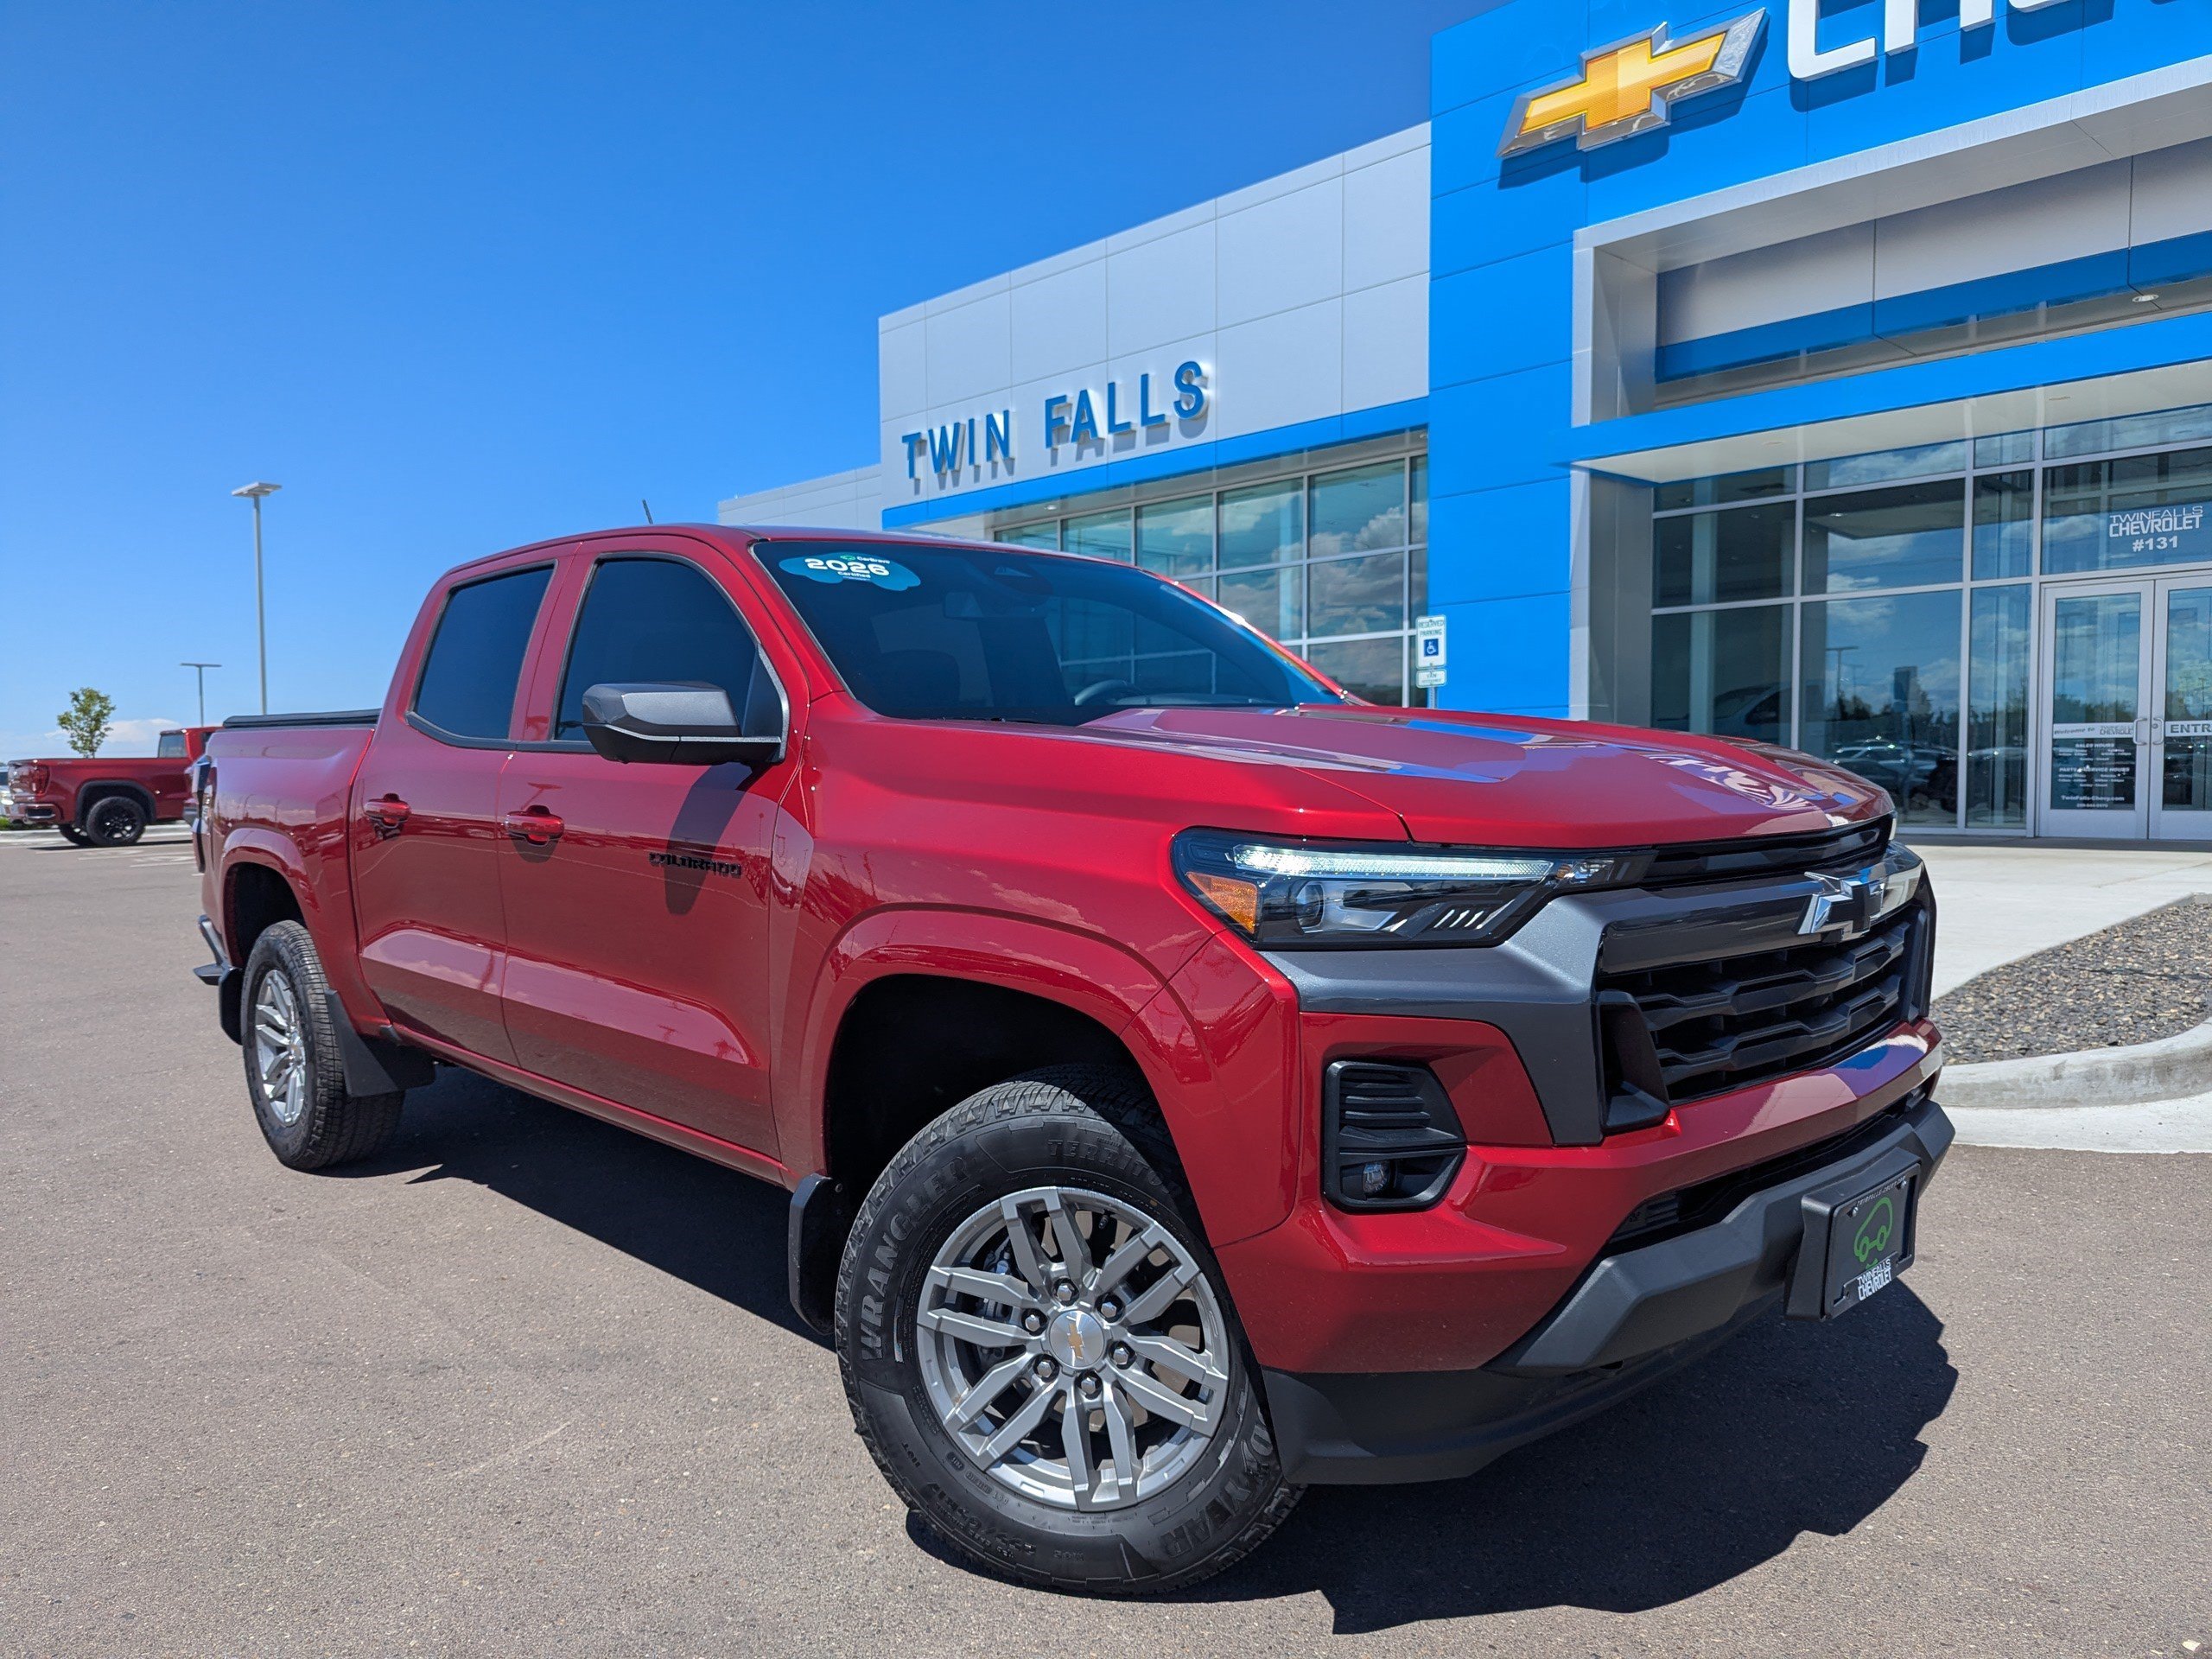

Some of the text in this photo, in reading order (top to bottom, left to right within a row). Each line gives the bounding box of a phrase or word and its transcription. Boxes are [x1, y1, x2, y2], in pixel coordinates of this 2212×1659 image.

[902, 360, 1208, 480] TWIN FALLS
[2109, 514, 2202, 537] CHEVROLET
[2133, 536, 2177, 552] #131
[804, 558, 890, 576] 2026
[2170, 723, 2212, 734] ENTR
[649, 853, 742, 877] COLORADO
[1047, 1139, 1166, 1192] TERRITO
[861, 1156, 969, 1361] WRANGLER
[1858, 1267, 1892, 1301] CHEVROLET
